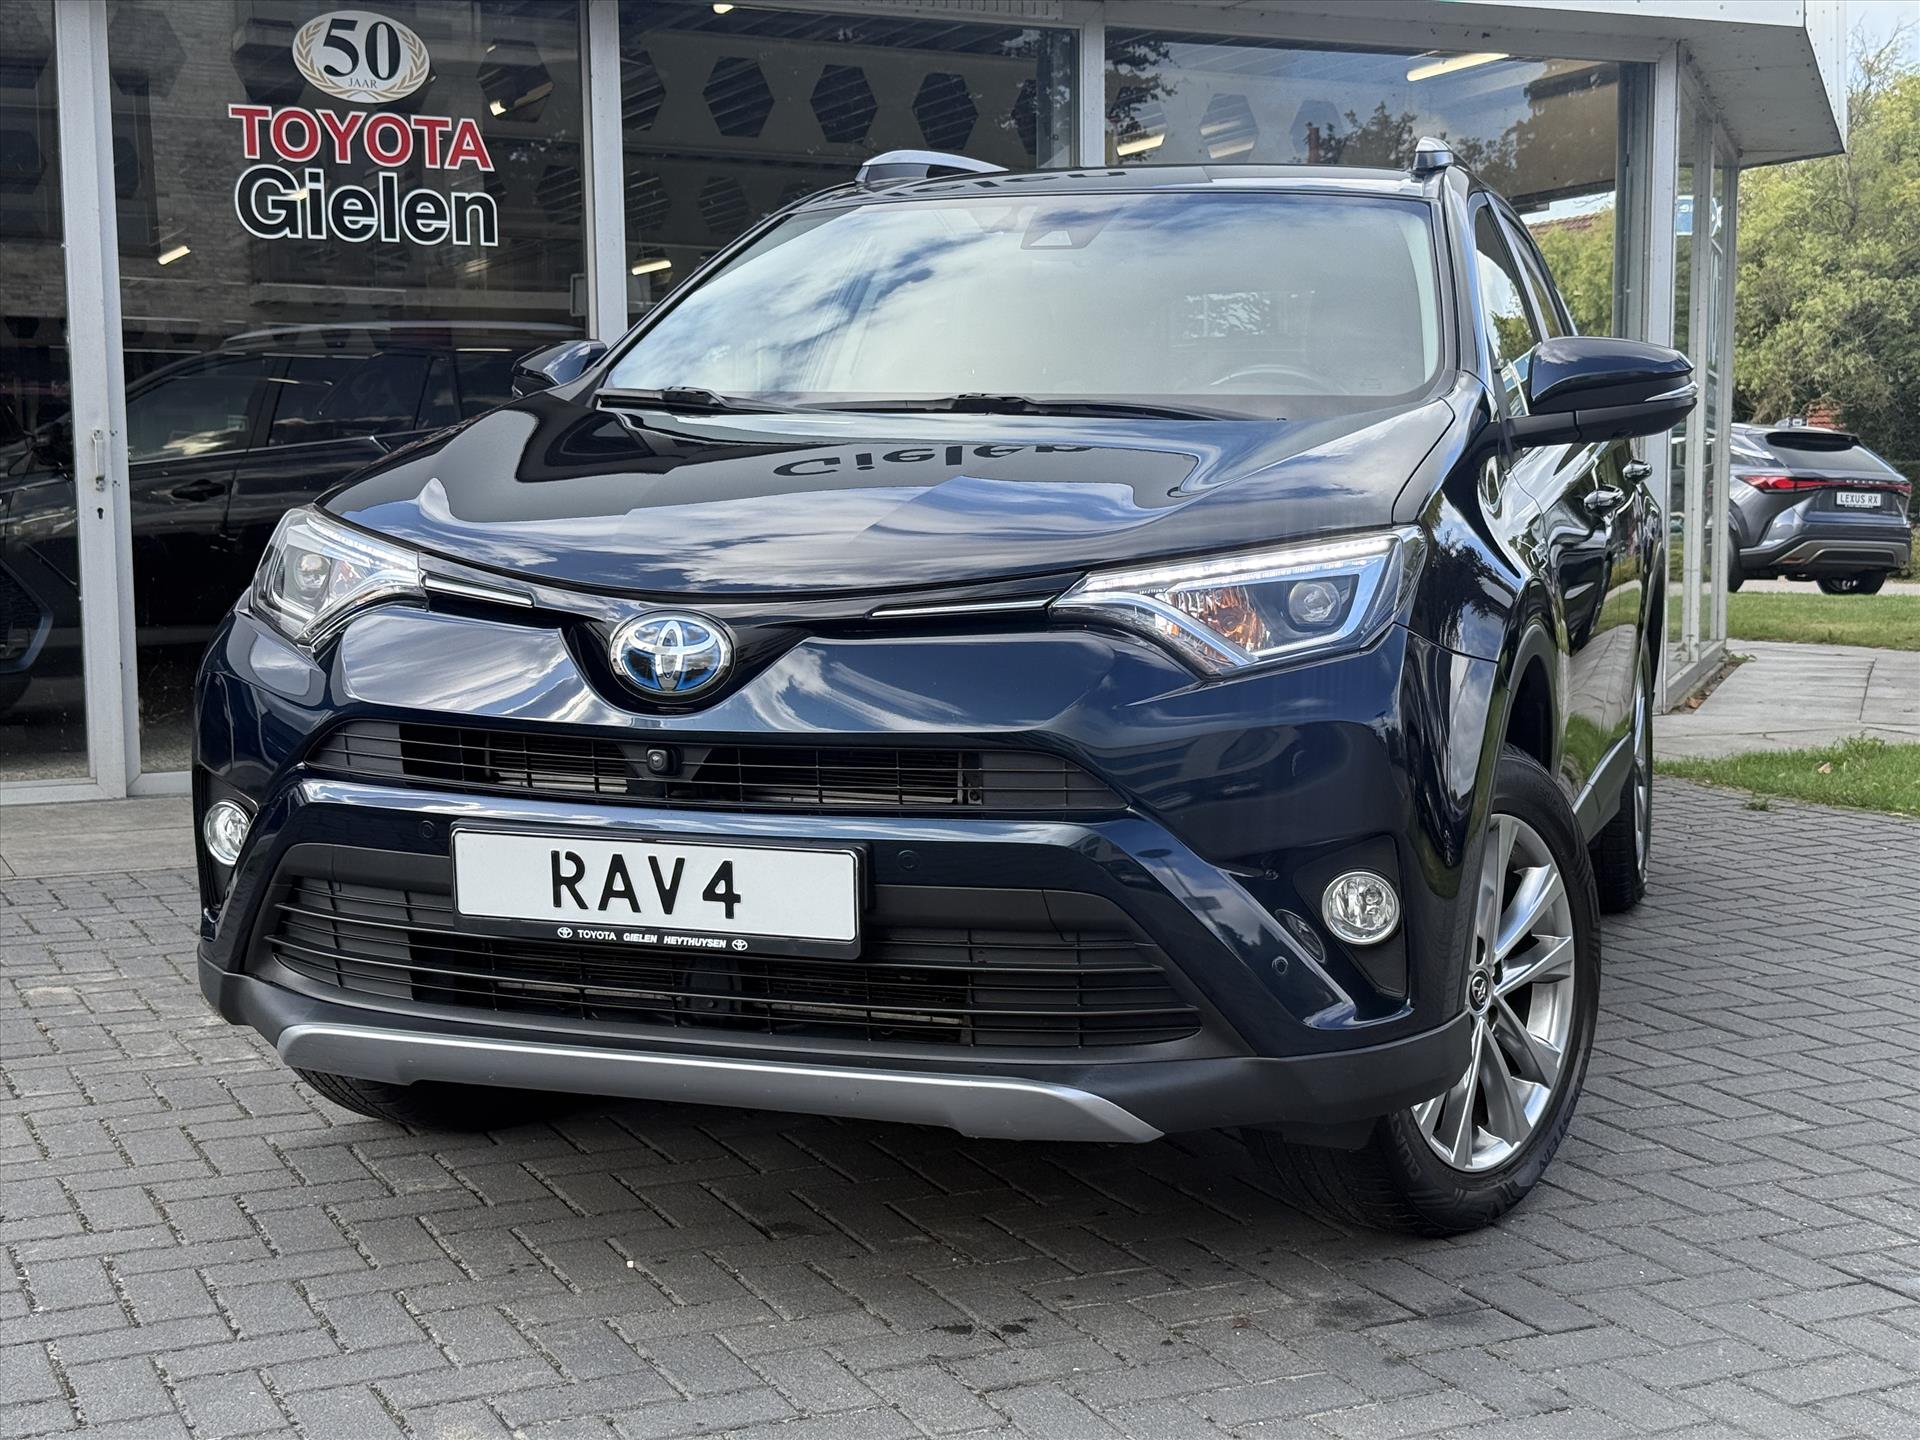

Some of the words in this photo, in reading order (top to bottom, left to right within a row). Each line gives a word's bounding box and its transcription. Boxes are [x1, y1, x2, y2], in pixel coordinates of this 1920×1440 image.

[323, 18, 401, 80] 50
[348, 78, 377, 89] JAAR
[228, 104, 495, 172] TOYOTA
[235, 164, 498, 247] Gielen
[1840, 494, 1865, 504] LEXUS
[1868, 495, 1878, 504] RX
[550, 850, 686, 914] RAV
[702, 860, 742, 919] 4
[577, 929, 617, 941] TOYOTA
[623, 933, 658, 943] GIELEN
[663, 935, 727, 948] HEYTHUYSEN
